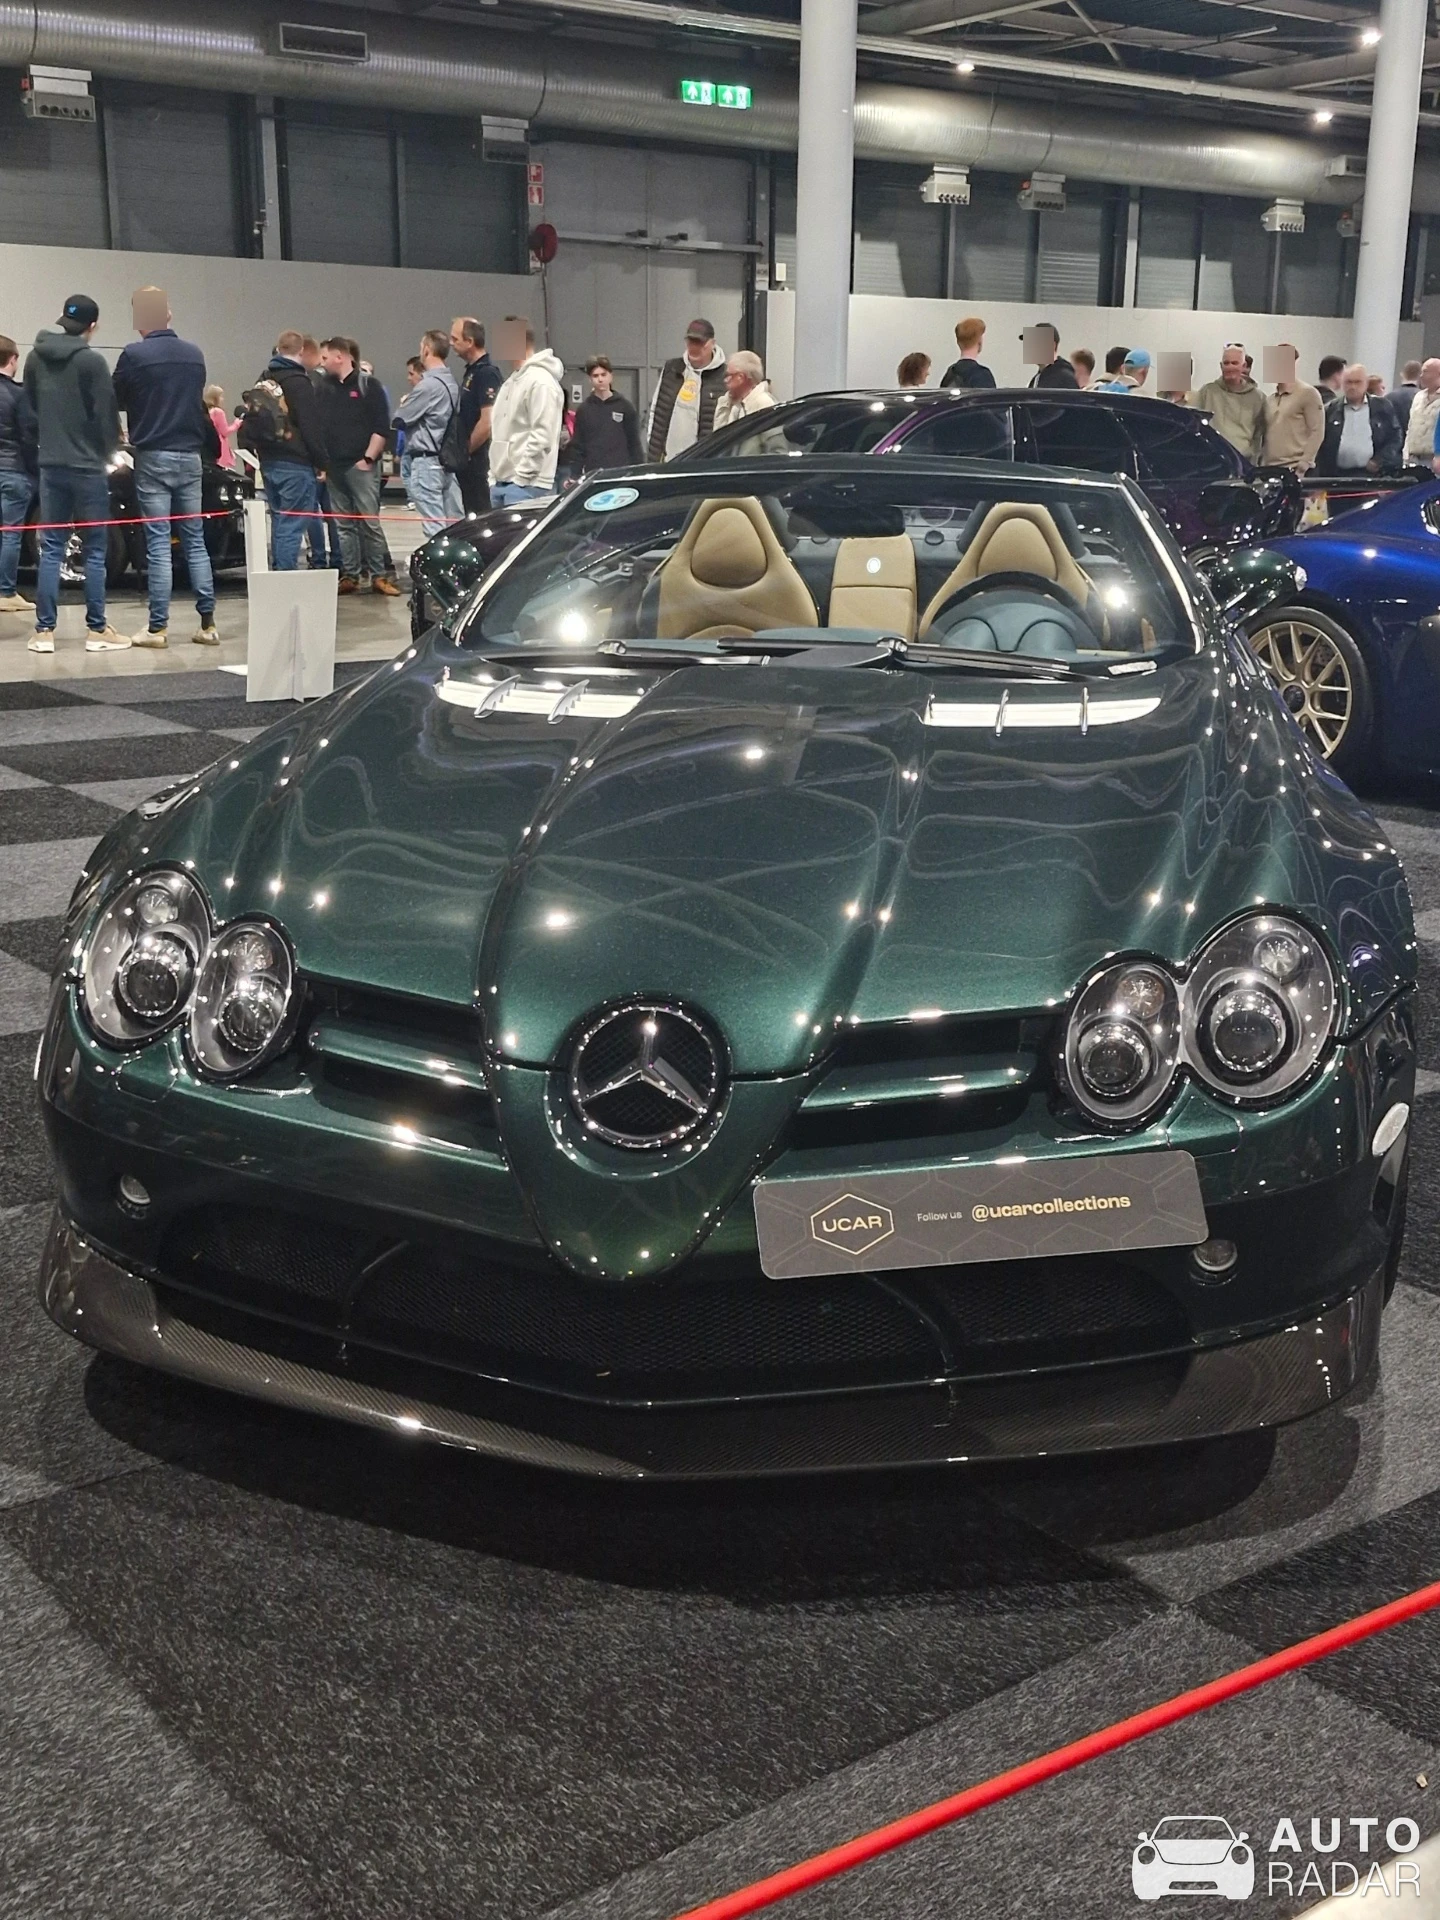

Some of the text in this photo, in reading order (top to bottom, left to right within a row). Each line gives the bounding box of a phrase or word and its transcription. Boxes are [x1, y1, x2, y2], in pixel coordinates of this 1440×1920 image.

[916, 1194, 1132, 1223] Follow us @ucarcollections
[821, 1215, 883, 1233] UCAR
